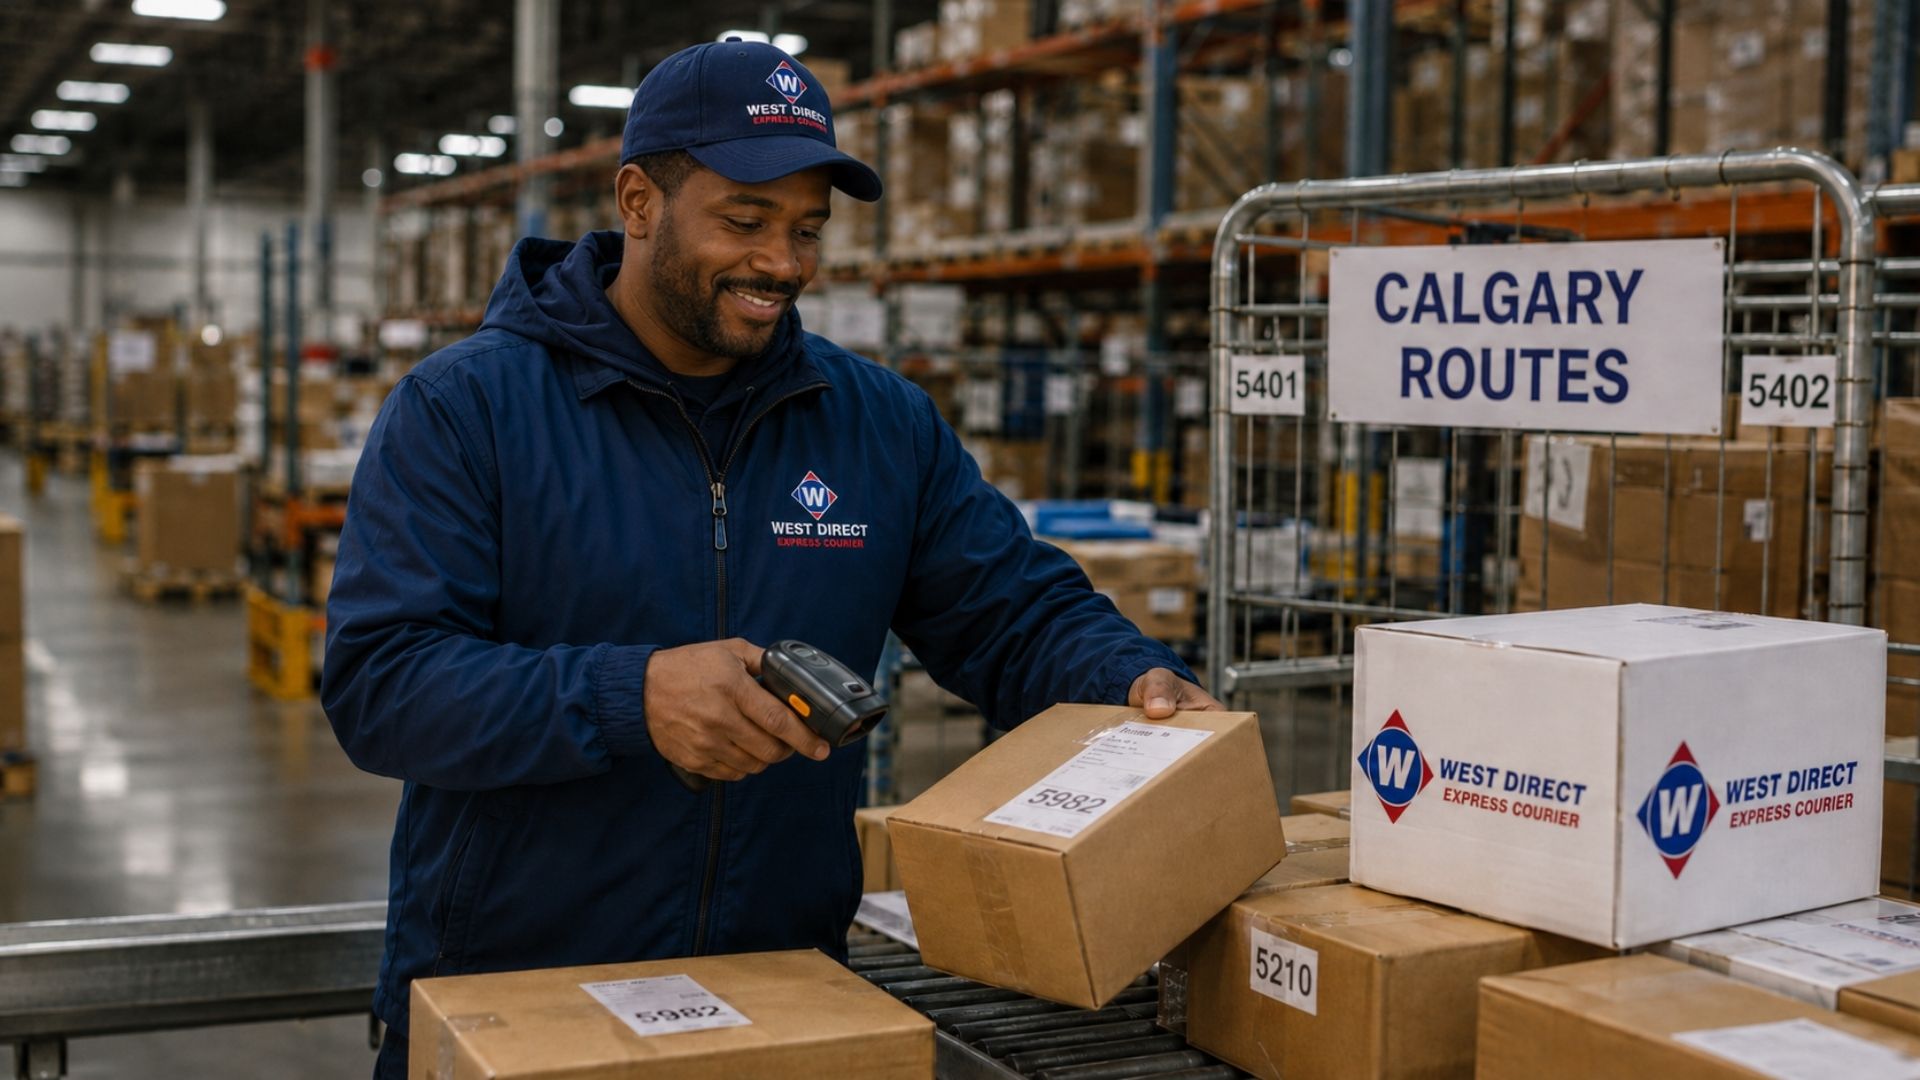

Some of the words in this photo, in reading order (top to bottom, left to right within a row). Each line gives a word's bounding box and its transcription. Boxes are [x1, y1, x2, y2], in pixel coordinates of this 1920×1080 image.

[775, 73, 797, 93] W
[746, 104, 788, 116] WEST
[791, 105, 827, 125] DIRECT
[1375, 269, 1645, 325] CALGARY
[1236, 370, 1296, 399] 5401
[1400, 346, 1630, 404] ROUTES
[1748, 373, 1830, 408] 5402
[801, 487, 825, 507] W
[771, 521, 813, 535] WEST
[817, 523, 868, 537] DIRECT
[777, 537, 821, 548] EXPRESS
[823, 538, 865, 549] COURIER
[1377, 744, 1416, 790] W
[1440, 758, 1498, 788] WEST
[1504, 771, 1587, 805] DIRECT
[1726, 773, 1782, 805] WEST
[1787, 761, 1858, 794] DIRECT
[1028, 788, 1106, 814] 5982
[1443, 787, 1508, 814] EXPRESS
[1512, 801, 1580, 828] COURIER
[1658, 783, 1702, 839] W
[1729, 803, 1791, 829] EXPRESS
[1795, 792, 1854, 818] COURIER
[1256, 946, 1312, 997] 5210
[635, 1005, 721, 1024] 5982
